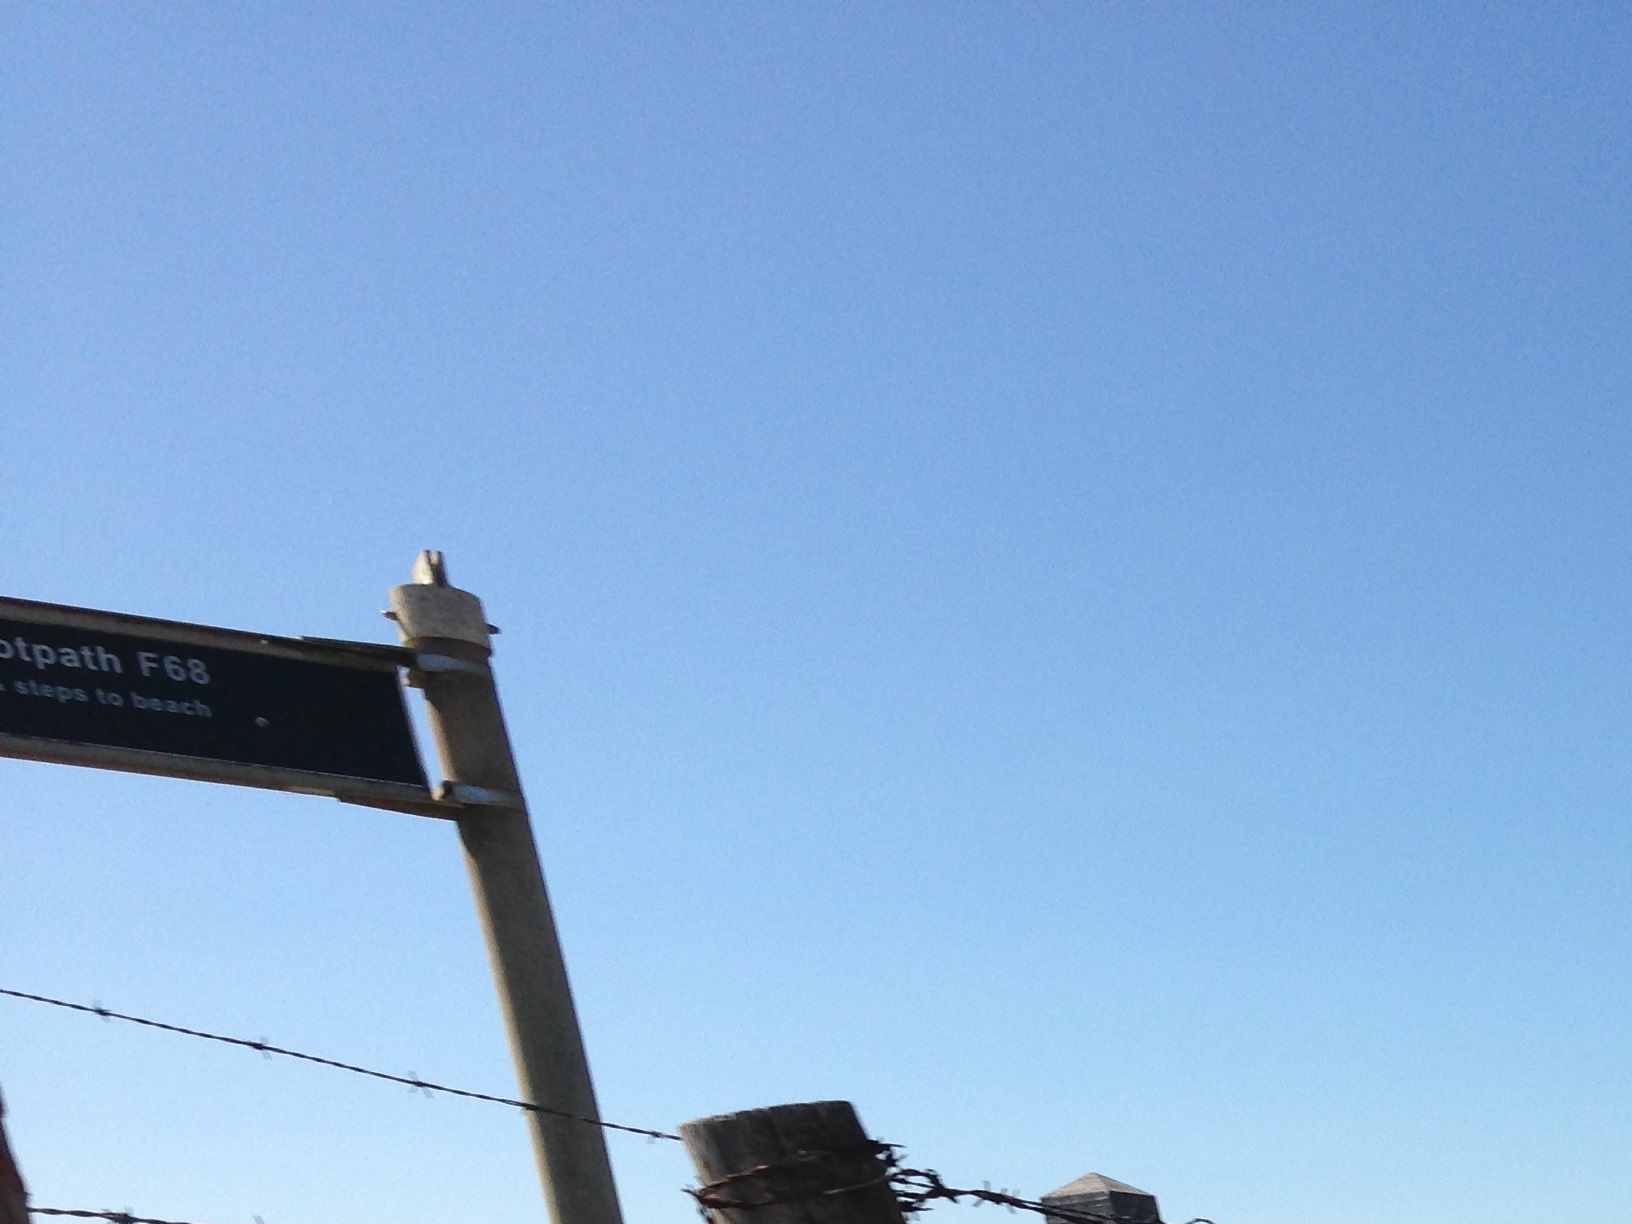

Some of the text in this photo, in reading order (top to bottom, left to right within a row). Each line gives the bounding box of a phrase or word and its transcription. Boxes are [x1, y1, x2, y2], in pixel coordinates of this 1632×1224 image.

[137, 651, 211, 685] F68
[14, 680, 213, 718] steps to beach
